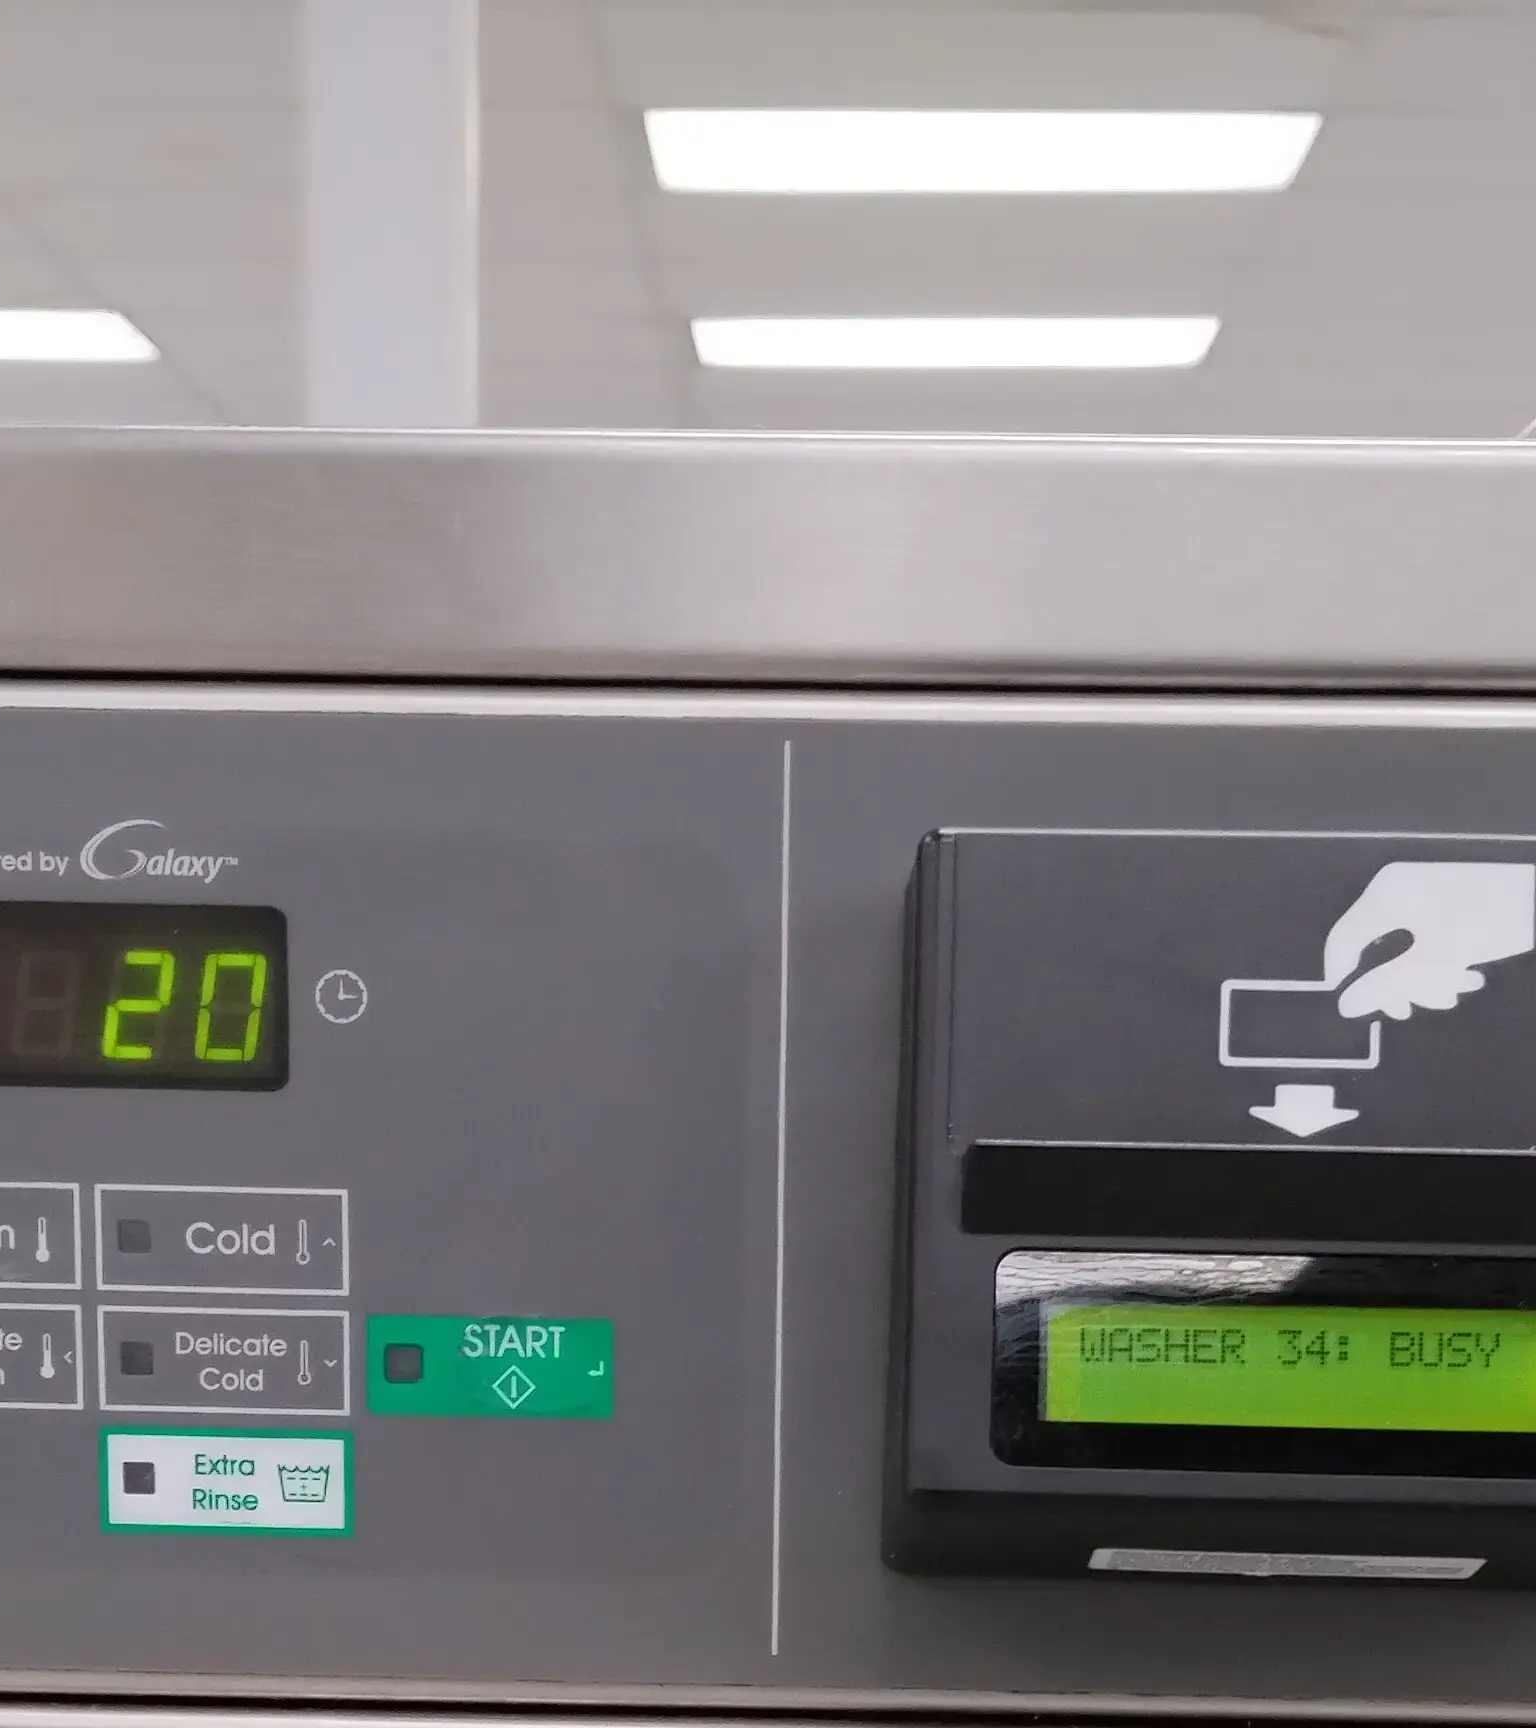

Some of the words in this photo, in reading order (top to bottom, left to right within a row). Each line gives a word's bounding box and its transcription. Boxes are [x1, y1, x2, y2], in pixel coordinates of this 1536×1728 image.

[38, 850, 69, 877] by
[100, 950, 268, 1061] 20
[185, 1221, 277, 1256] Cold
[175, 1331, 287, 1357] Delicate
[462, 1324, 566, 1358] START
[1079, 1326, 1247, 1364] WASHER
[1276, 1329, 1350, 1366] 34:
[1388, 1331, 1502, 1369] BUSY
[199, 1367, 265, 1392] Cold
[194, 1454, 256, 1477] Extra
[191, 1488, 259, 1513] Rinse
